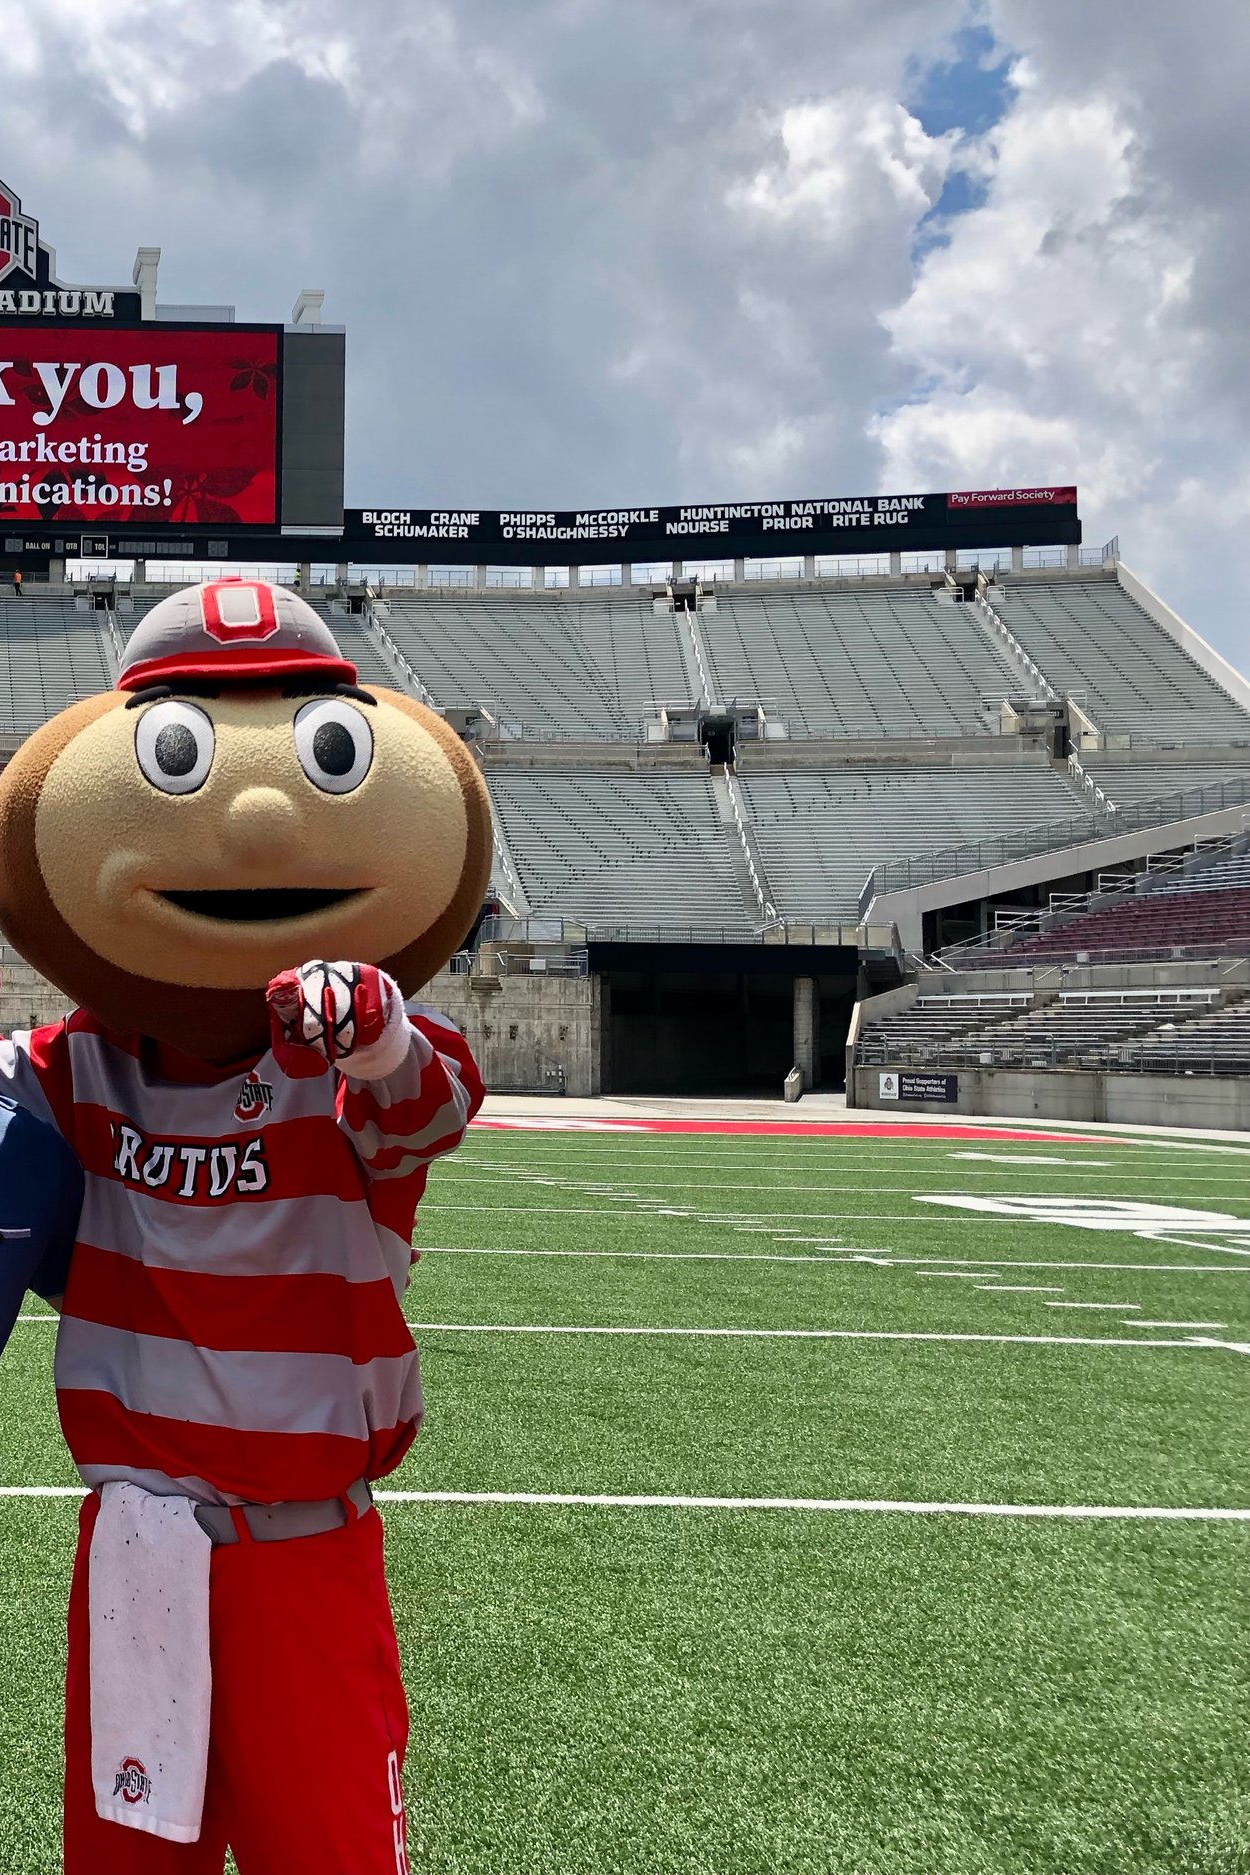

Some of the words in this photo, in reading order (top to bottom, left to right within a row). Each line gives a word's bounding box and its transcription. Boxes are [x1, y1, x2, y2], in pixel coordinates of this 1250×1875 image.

[30, 357, 205, 426] you,
[951, 492, 969, 504] Pay
[971, 490, 1015, 502] Forward
[1015, 489, 1055, 501] Society
[680, 504, 785, 521] HUNTINGTON
[790, 500, 873, 517] NATIONAL
[876, 497, 925, 512] BANK
[362, 511, 411, 525] BLOCH
[430, 512, 480, 526] CRANE
[499, 513, 556, 527] PHIPPS
[575, 510, 659, 527] McCORKLE
[762, 516, 814, 531] PRIOR
[832, 513, 871, 528] RITE
[872, 511, 909, 526] RUG
[374, 525, 469, 539] SCHUMAKER
[502, 525, 630, 540] O'SHAUGHNESSY
[665, 520, 729, 535] NOURSE
[25, 541, 40, 550] BALL
[42, 542, 51, 551] ON
[198, 579, 280, 645] O
[110, 1123, 267, 1197] RUTUS
